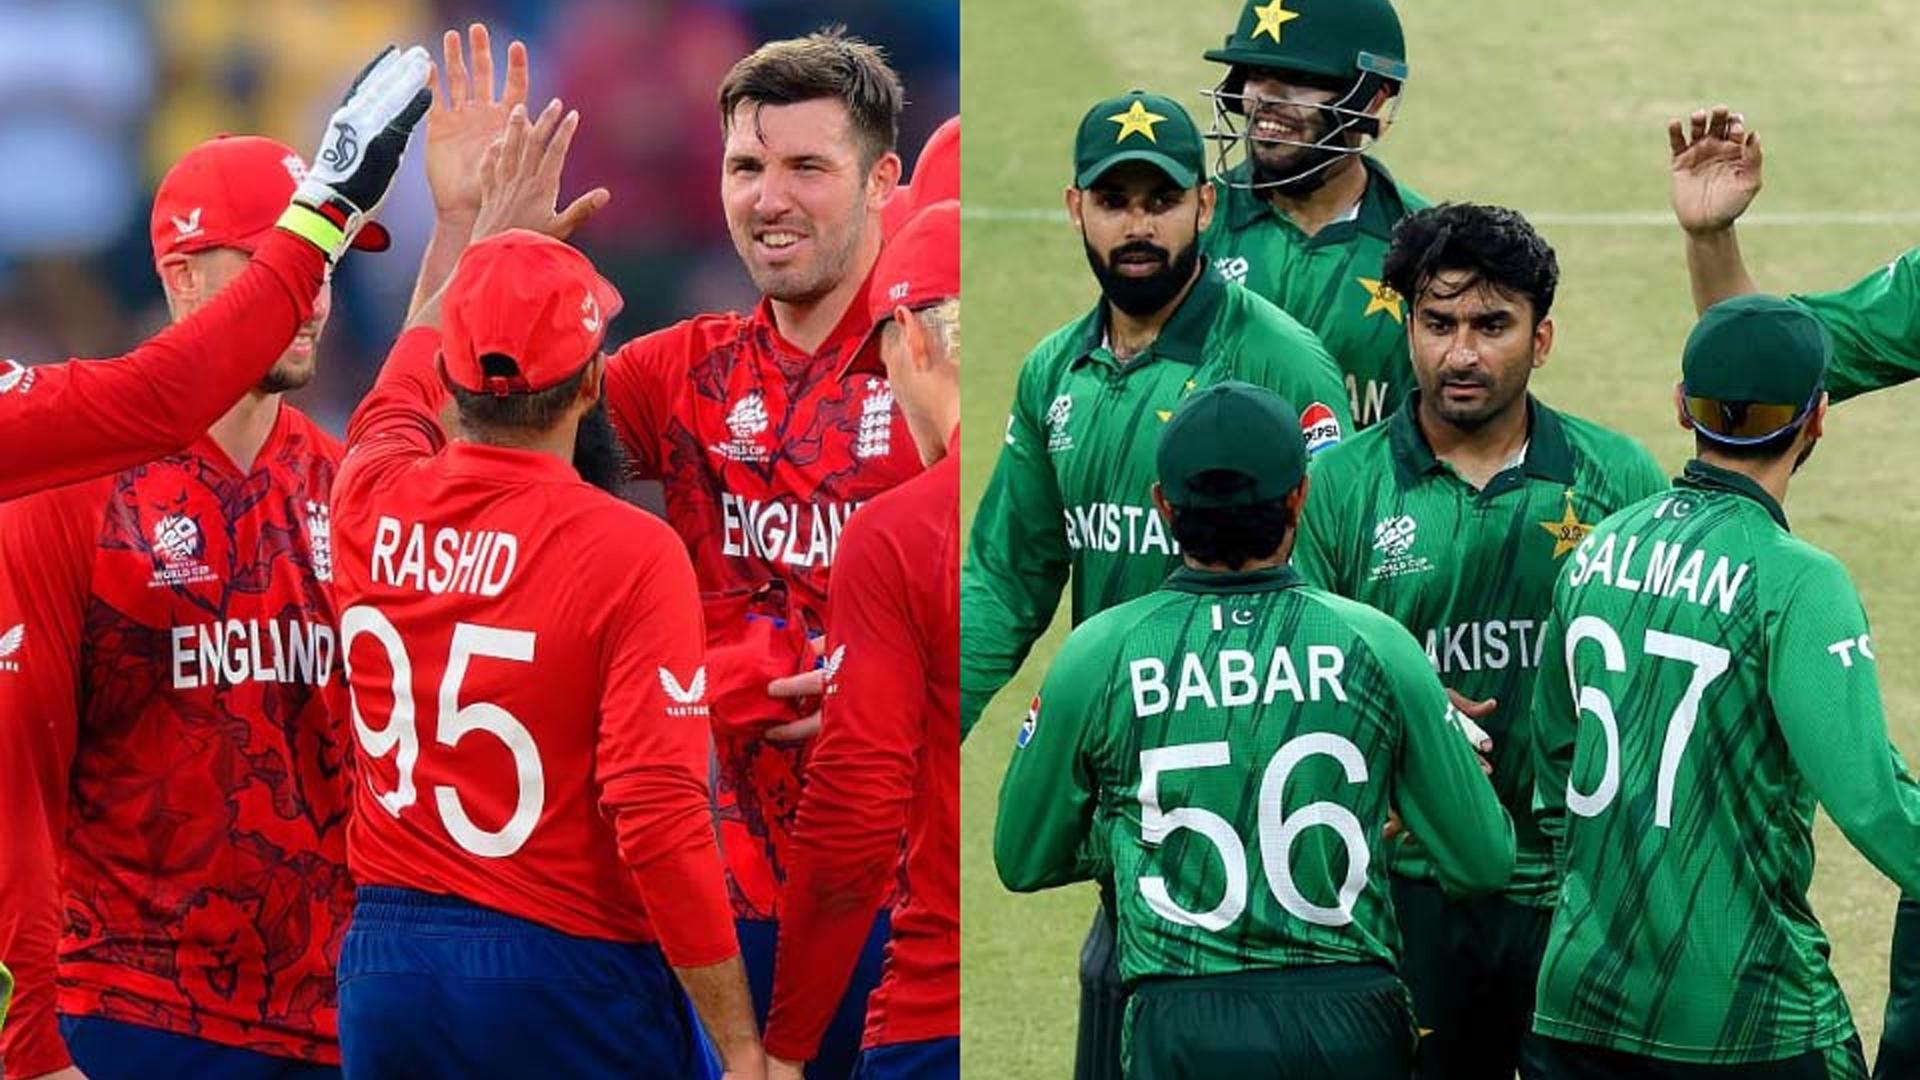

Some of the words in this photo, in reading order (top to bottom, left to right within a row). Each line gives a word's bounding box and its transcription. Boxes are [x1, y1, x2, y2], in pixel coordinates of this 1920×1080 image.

[371, 514, 518, 597] RASHID
[721, 492, 866, 568] ENGLAN
[1372, 561, 1407, 575] WORLD
[1570, 532, 1749, 615] SALMAN
[172, 619, 335, 689] ENGLAND
[1130, 645, 1348, 717] BABAR
[340, 605, 545, 858] 95
[1565, 615, 1731, 828] 67
[1138, 732, 1370, 932] 56
